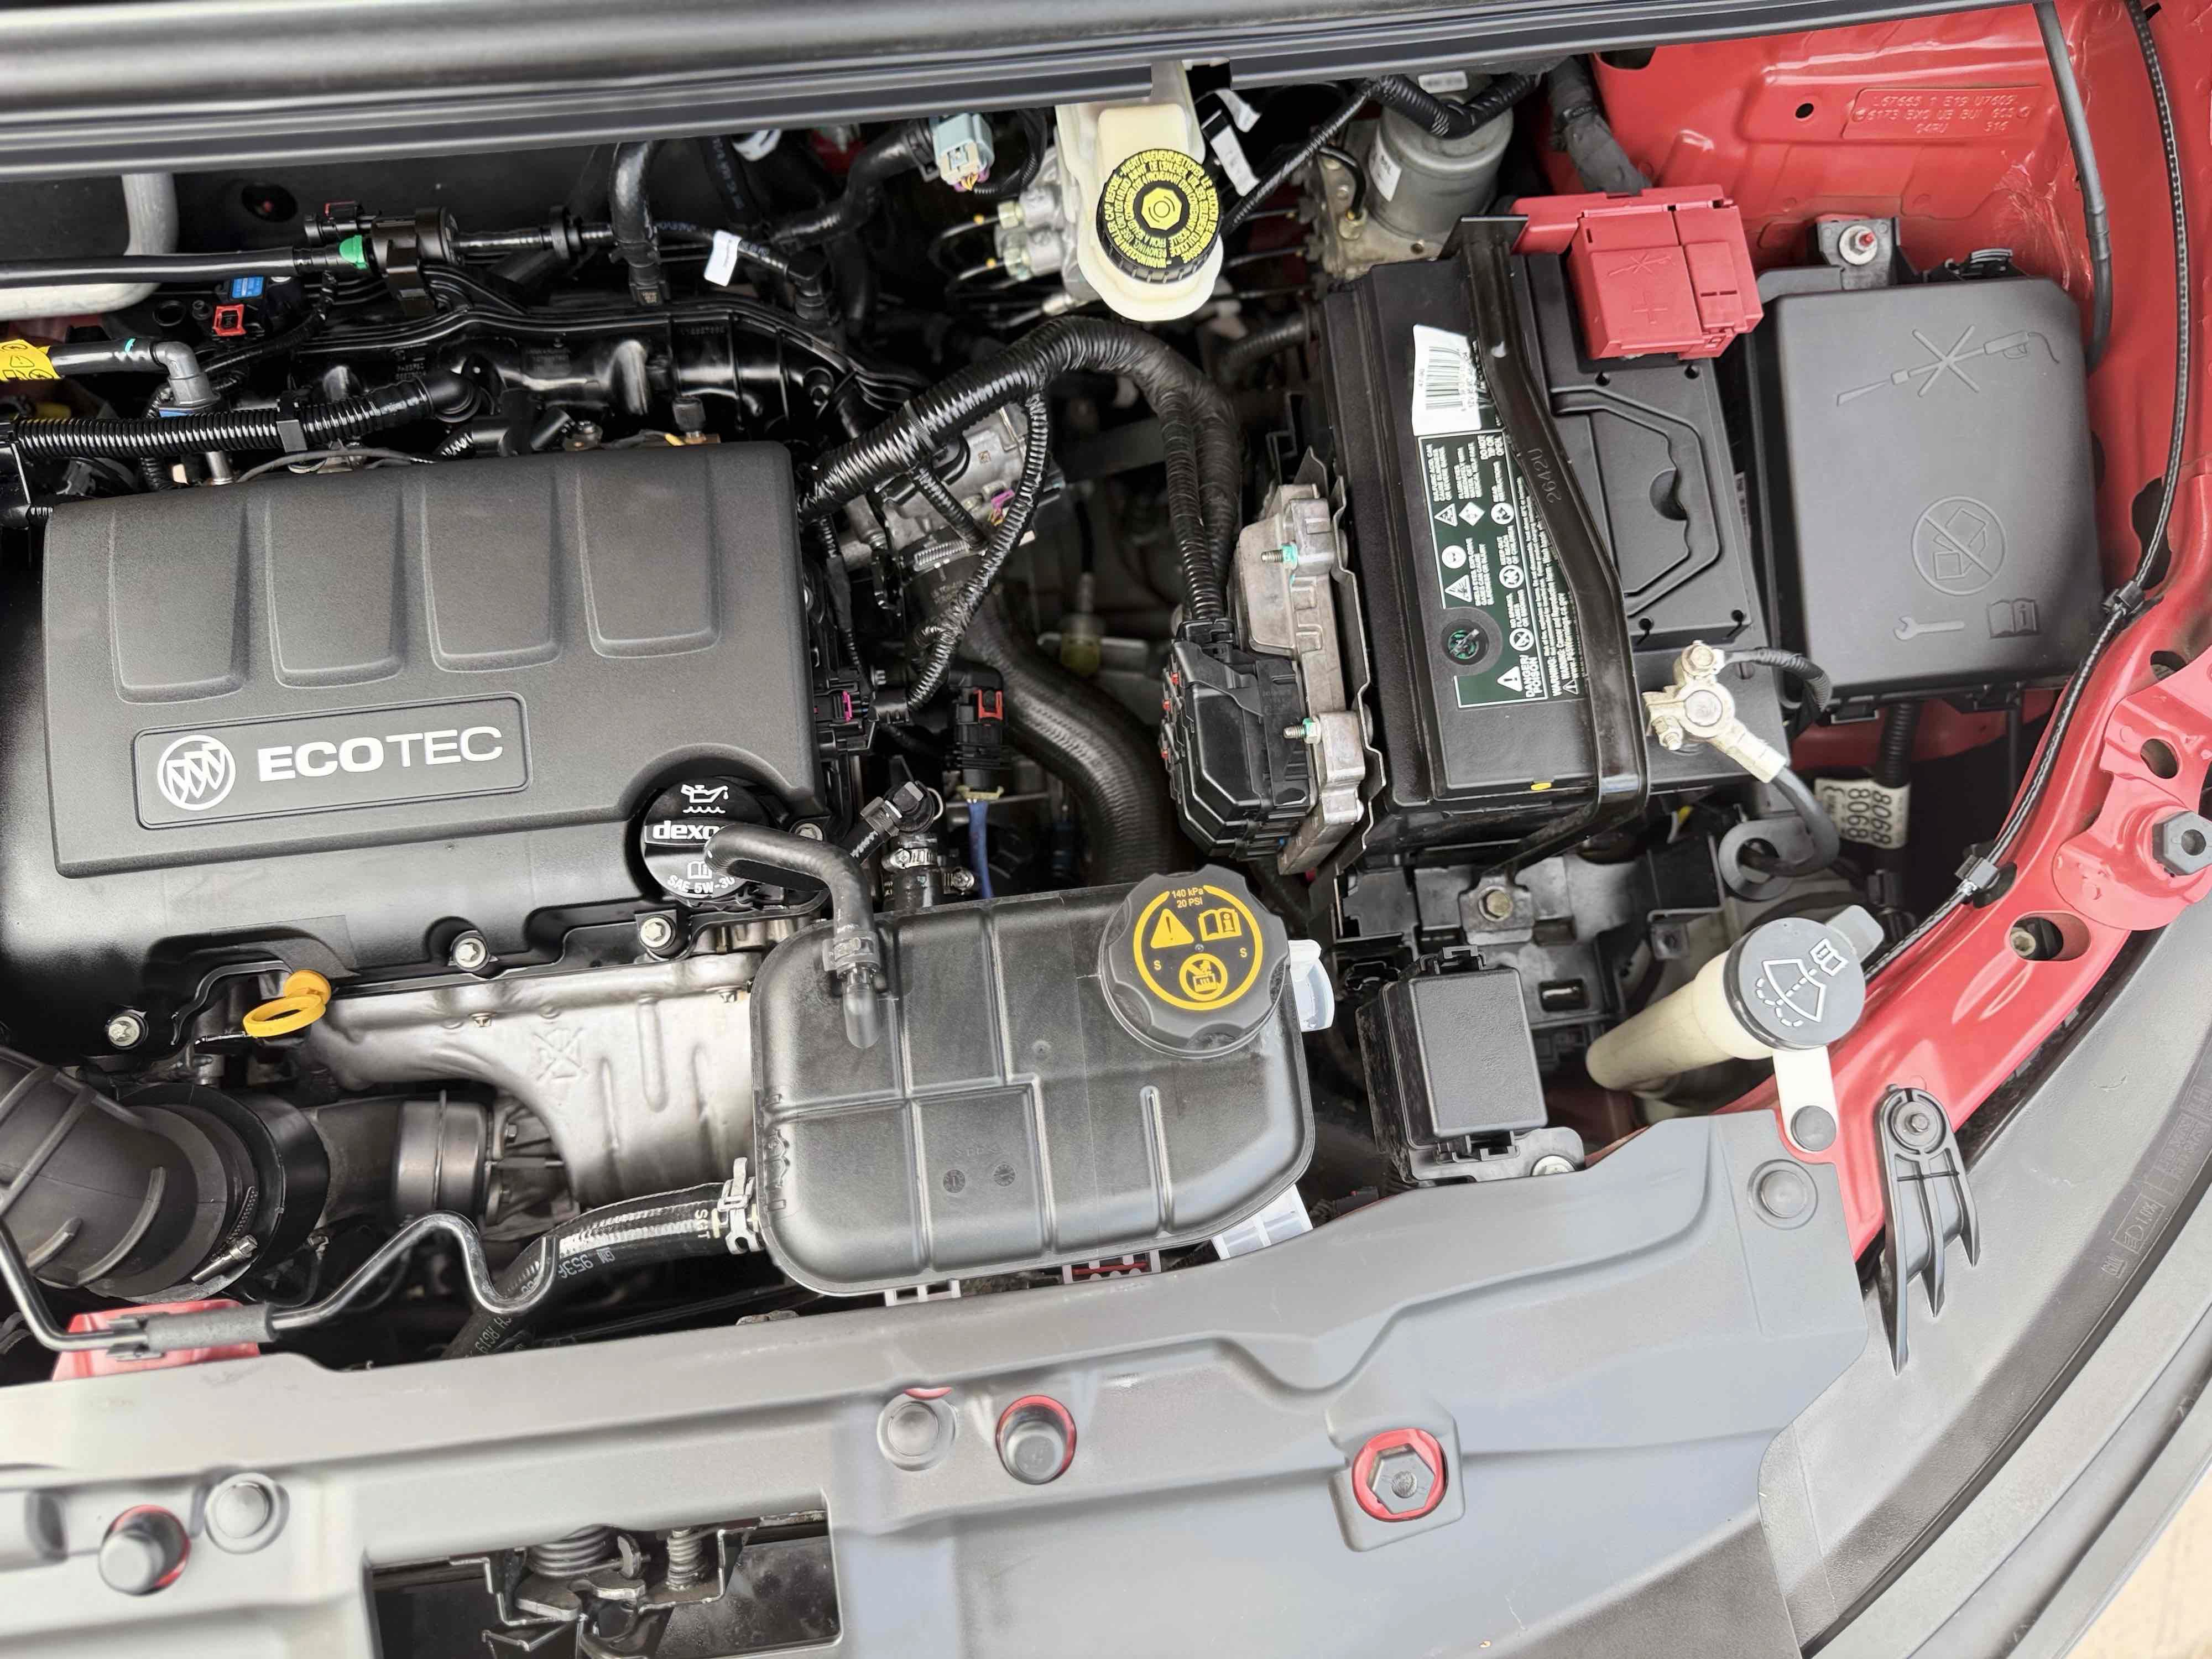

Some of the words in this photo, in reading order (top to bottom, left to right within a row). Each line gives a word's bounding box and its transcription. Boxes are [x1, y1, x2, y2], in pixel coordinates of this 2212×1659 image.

[1478, 435, 1486, 449] NOT
[1528, 656, 1542, 693] POISON
[1547, 656, 1562, 696] WARNING:
[257, 726, 503, 782] ECOTEC
[653, 820, 720, 839] dexo
[667, 875, 690, 893] SAE
[1171, 889, 1186, 899] 140
[1187, 887, 1204, 896] kPa
[1176, 900, 1187, 908] 20
[1188, 897, 1203, 907] PSI
